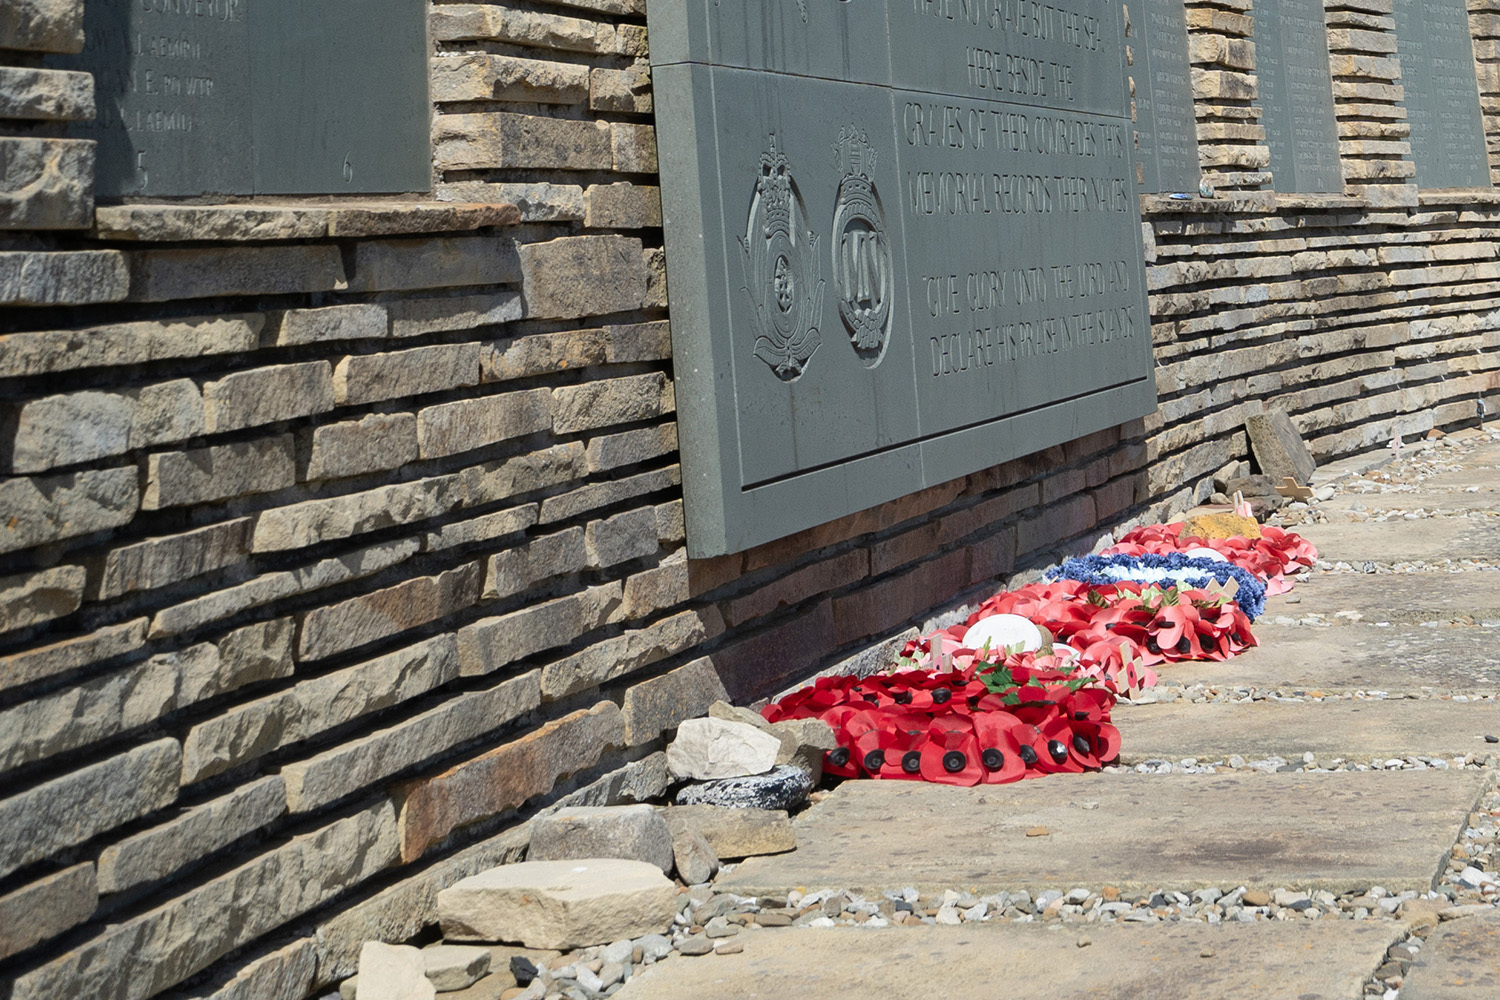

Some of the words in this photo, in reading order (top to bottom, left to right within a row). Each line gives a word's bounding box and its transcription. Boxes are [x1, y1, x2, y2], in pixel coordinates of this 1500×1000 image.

[1030, 0, 1056, 42] BUT
[1056, 7, 1083, 50] THE
[965, 45, 1005, 94] HERE
[1005, 52, 1048, 99] BESIDE
[1048, 60, 1076, 102] THE
[902, 101, 966, 151] GRAVES
[967, 107, 989, 152] OF
[989, 109, 1033, 154] THEIR
[1033, 115, 1098, 159] COMRADES
[1097, 122, 1125, 160] THIS
[136, 148, 150, 191] 5
[341, 148, 355, 185] 6
[906, 170, 993, 217] MEMORIAL
[992, 171, 1054, 216] RECORDS
[1053, 174, 1091, 215] THEIR
[1090, 176, 1130, 215] NAMES
[965, 269, 1008, 313] GLORY
[1011, 264, 1048, 308] UNTO
[1049, 263, 1076, 302] THE
[1076, 260, 1107, 300] LORD
[1107, 258, 1131, 296] AND
[928, 326, 994, 379] DECLARE
[994, 322, 1019, 365] HIS
[1018, 317, 1060, 360] PRAISE
[1059, 314, 1072, 352] IN
[1071, 310, 1096, 349] THE
